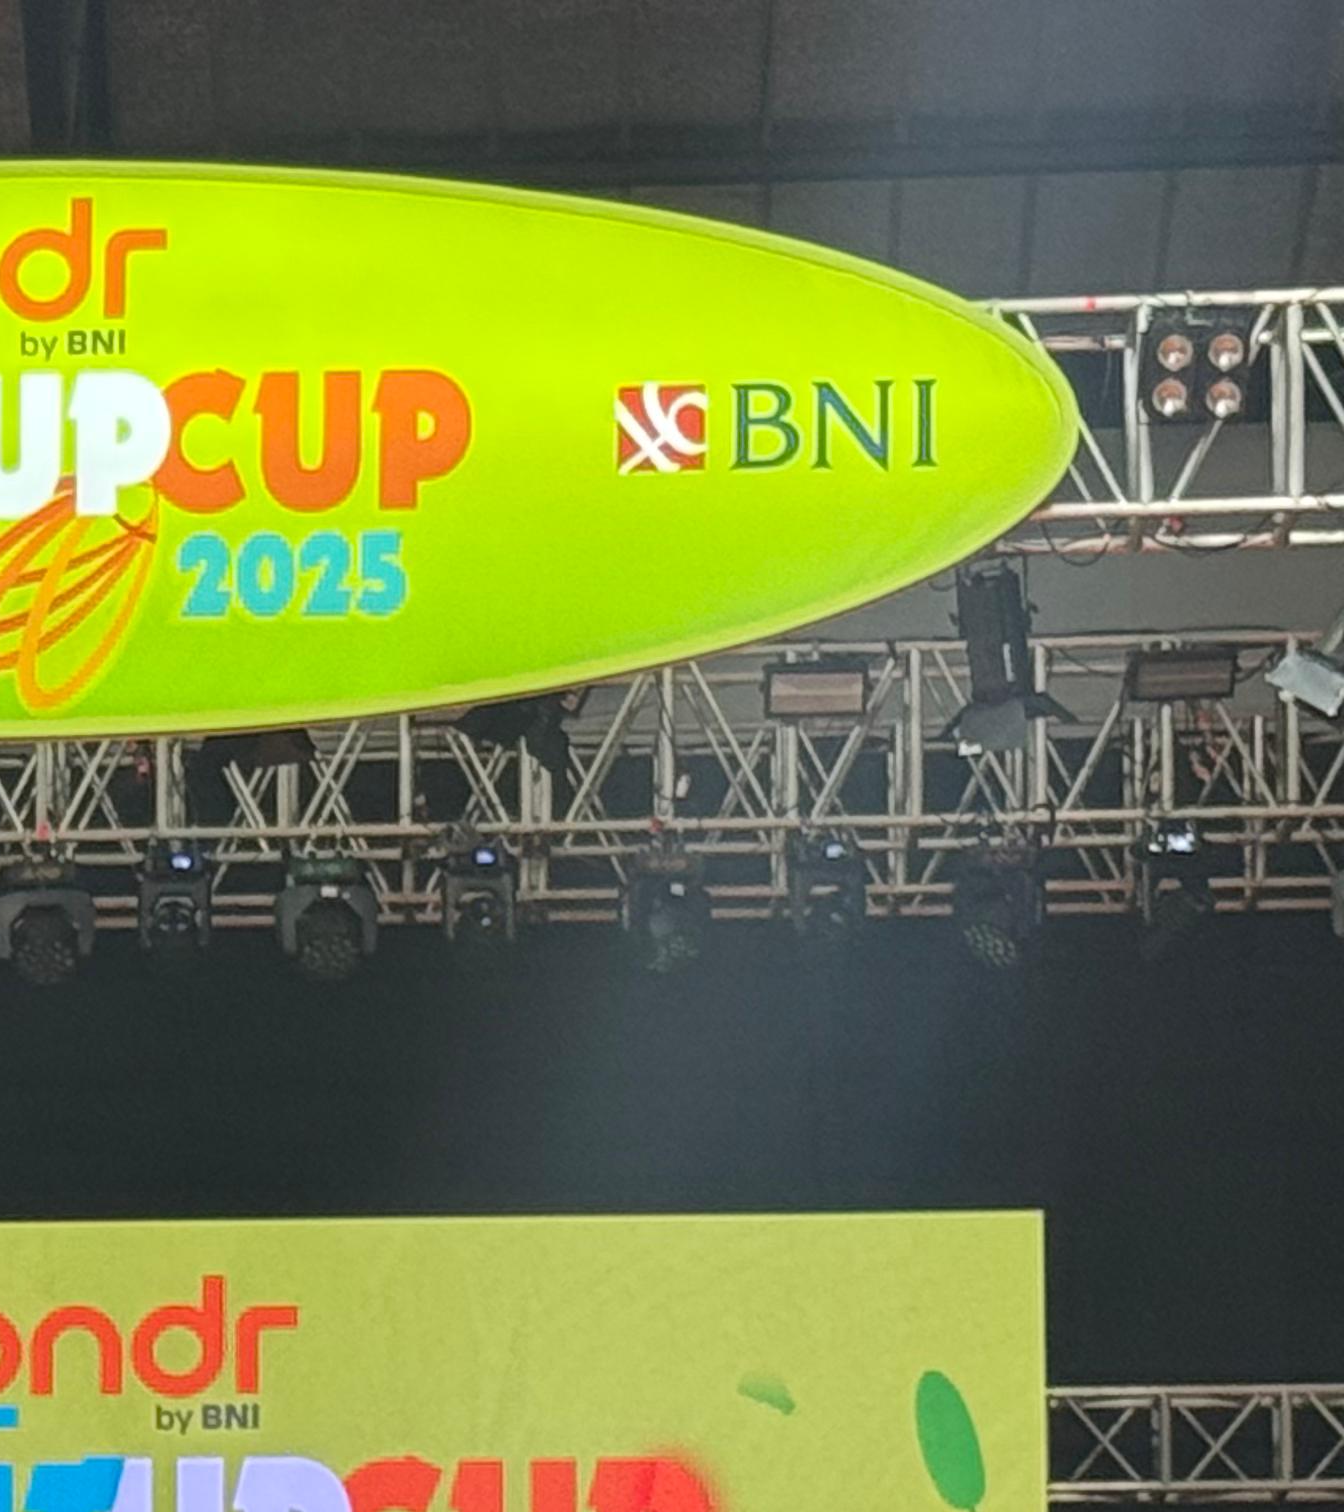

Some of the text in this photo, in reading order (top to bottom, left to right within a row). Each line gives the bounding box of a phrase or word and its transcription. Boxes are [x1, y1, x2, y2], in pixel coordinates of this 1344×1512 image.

[20, 329, 126, 361] by BNI
[729, 378, 938, 472] BNI
[178, 532, 407, 618] 2025
[155, 1405, 259, 1434] by BNI
